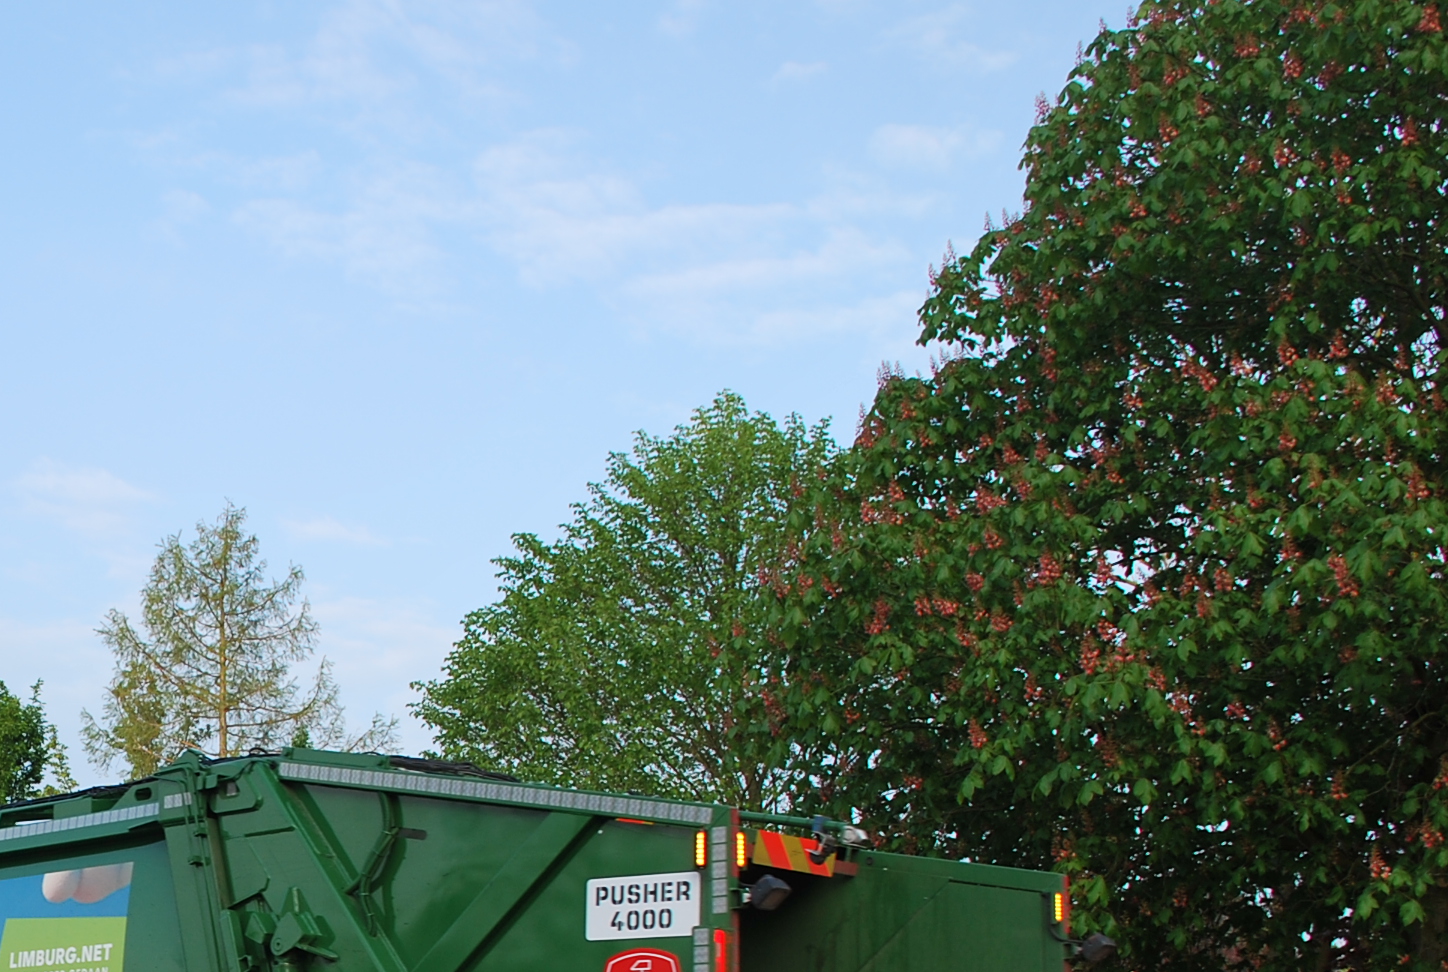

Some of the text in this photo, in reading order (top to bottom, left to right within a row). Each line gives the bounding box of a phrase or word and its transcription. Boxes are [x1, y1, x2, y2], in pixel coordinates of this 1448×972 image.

[595, 880, 691, 907] PUSHER
[610, 908, 673, 931] 4000
[9, 942, 113, 969] LIMBURG.NET
